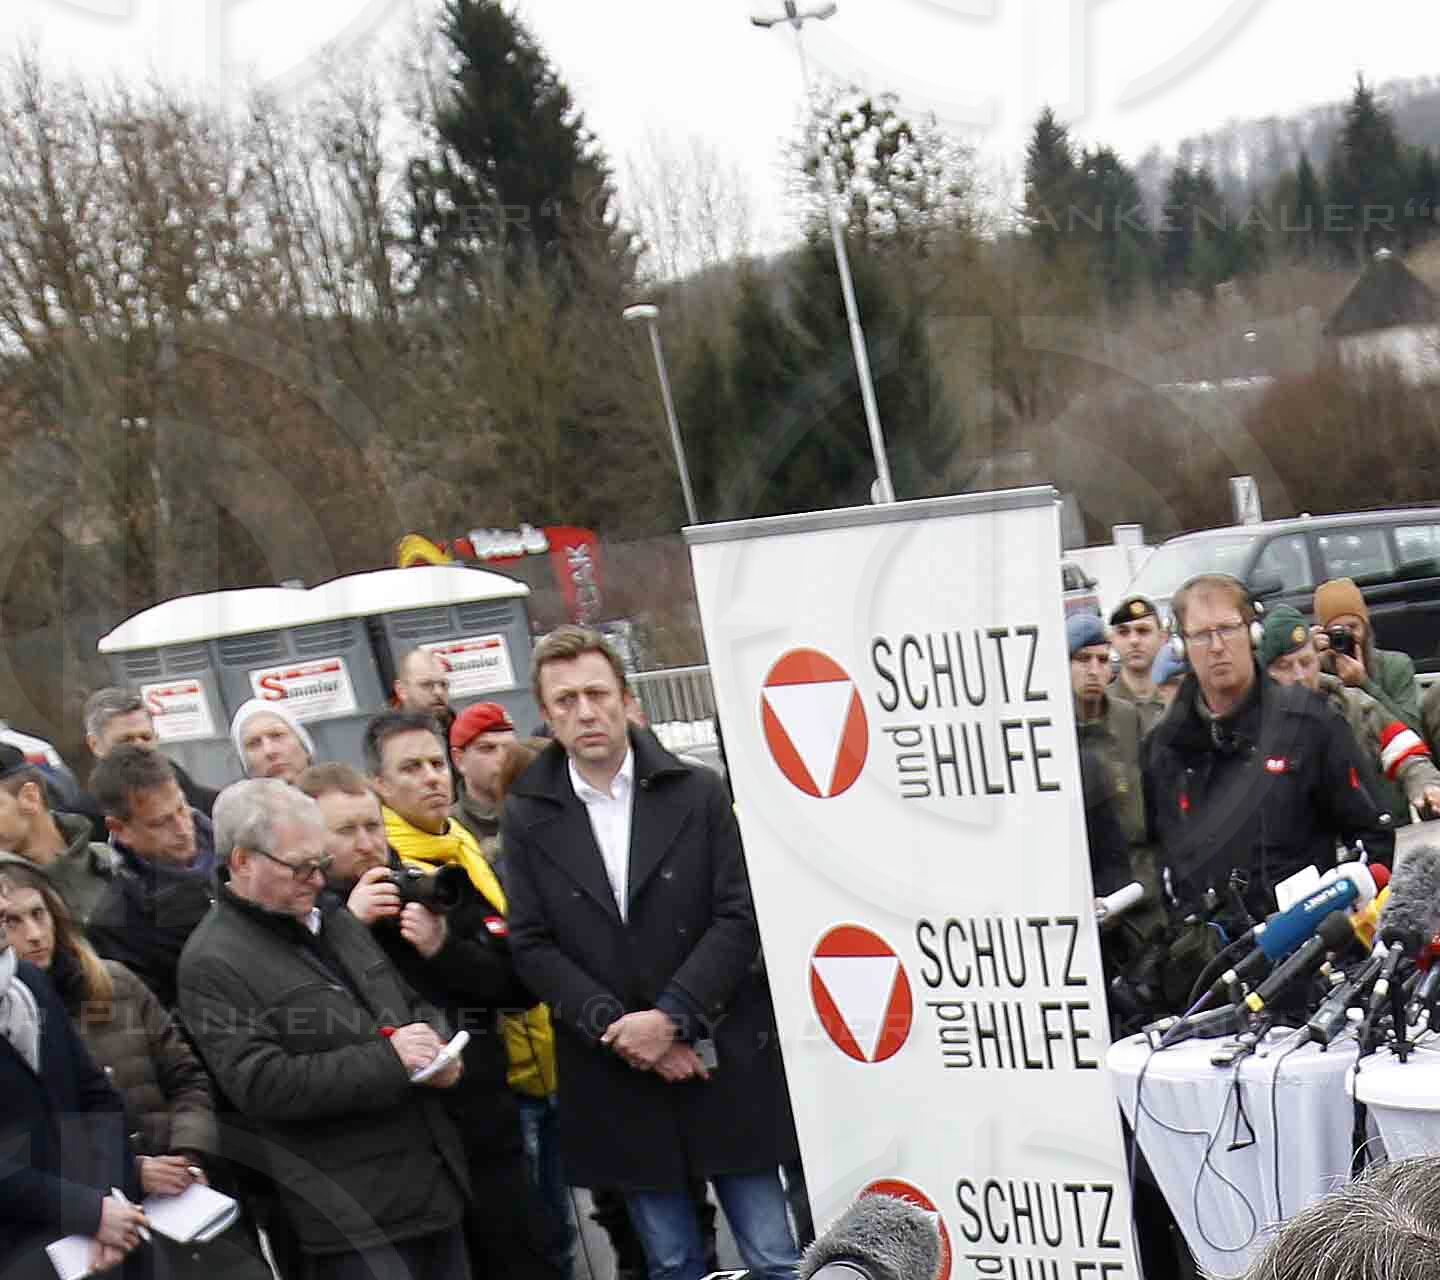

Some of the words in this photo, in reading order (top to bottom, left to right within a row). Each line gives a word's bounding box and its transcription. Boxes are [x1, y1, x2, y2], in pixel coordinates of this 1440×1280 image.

[872, 626, 1047, 712] SCHUTZ
[884, 726, 931, 799] und
[931, 718, 1060, 797] HILFE
[916, 916, 1089, 989] SCHUTZ
[928, 999, 976, 1068] und
[973, 999, 1095, 1070] HILFE
[957, 1179, 1121, 1248] SCHUTZ
